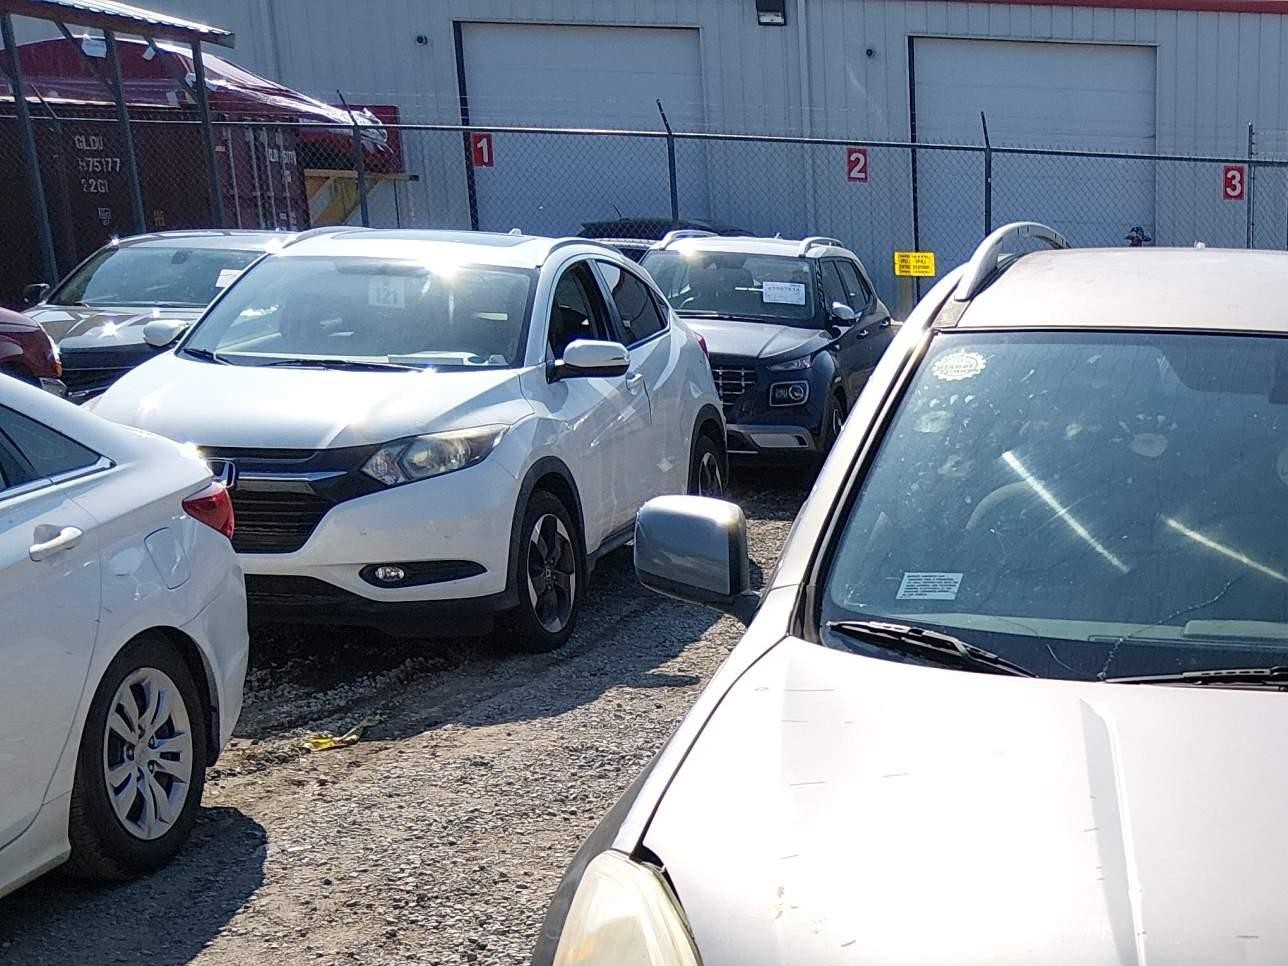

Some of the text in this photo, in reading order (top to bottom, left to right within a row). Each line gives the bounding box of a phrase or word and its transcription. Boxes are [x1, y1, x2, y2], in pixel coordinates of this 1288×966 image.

[477, 138, 488, 163] 1
[850, 152, 865, 178] 2
[1226, 170, 1241, 196] 3
